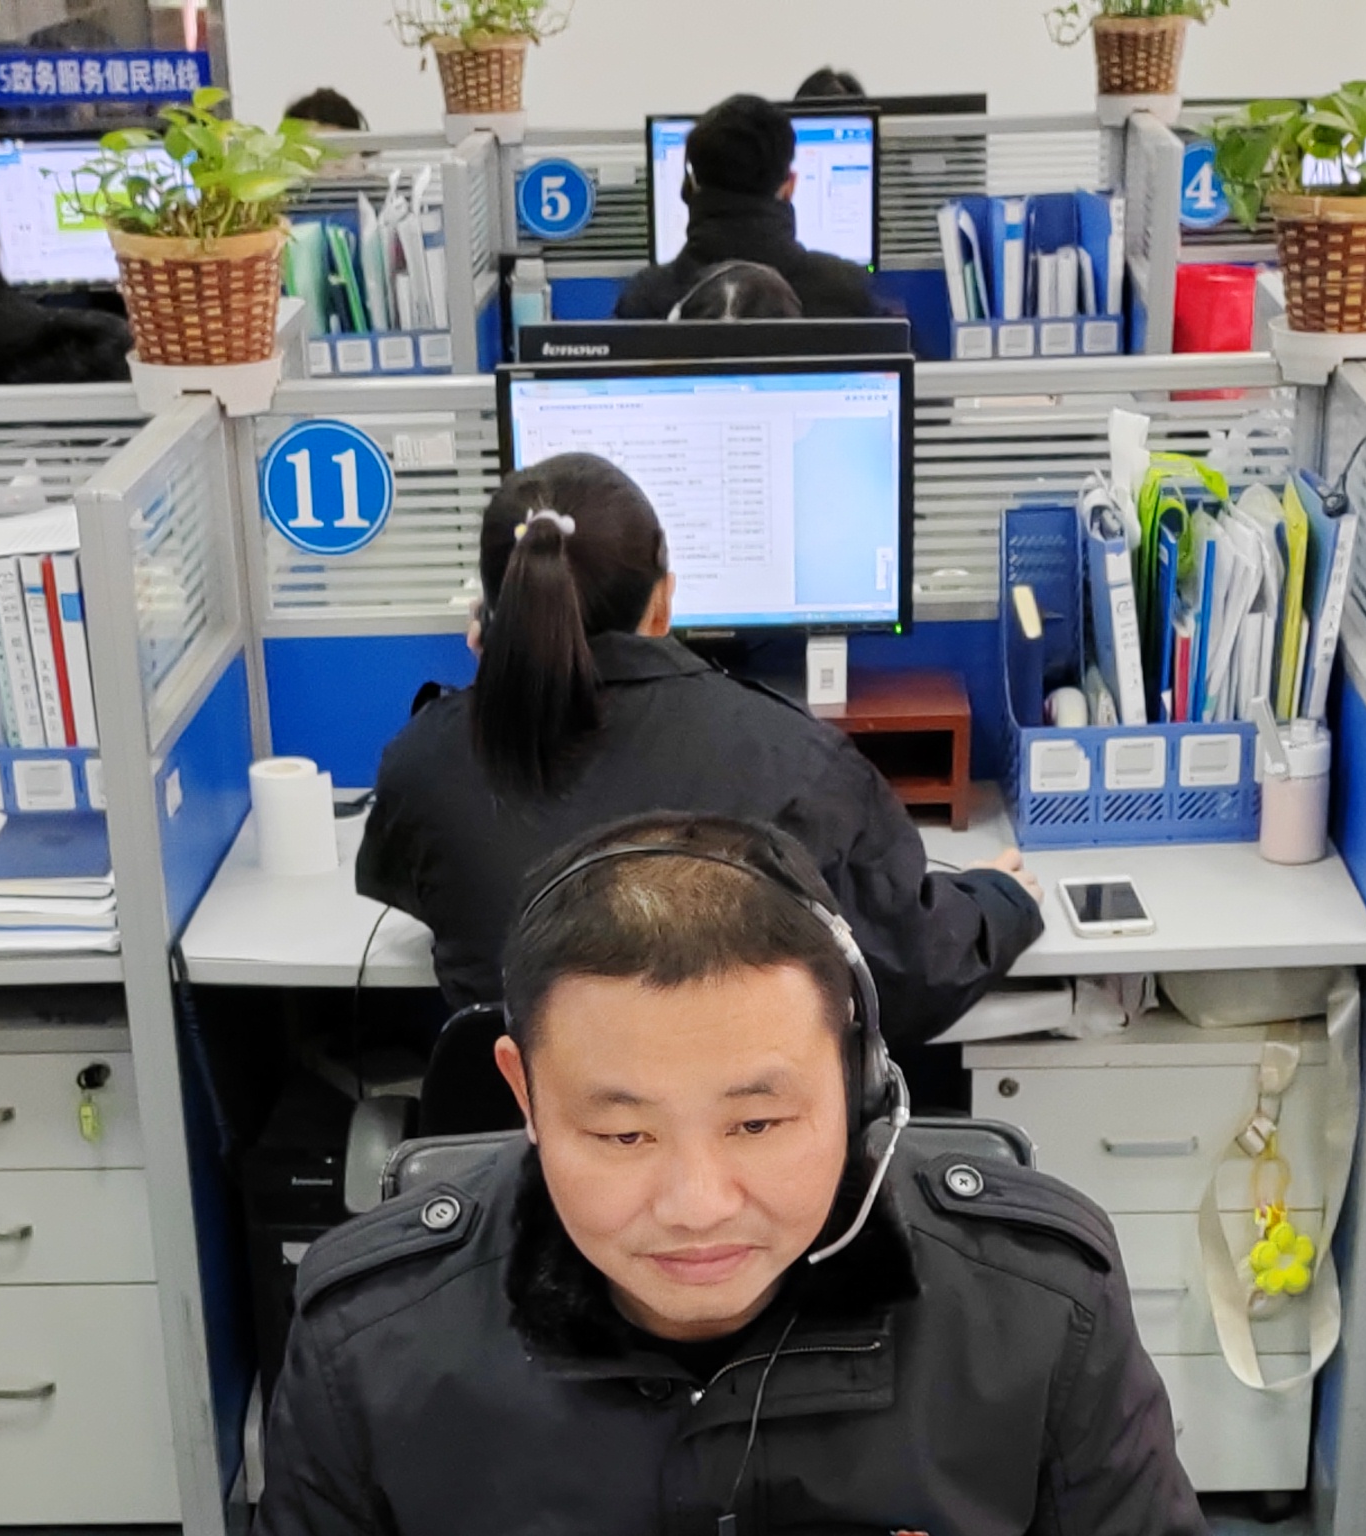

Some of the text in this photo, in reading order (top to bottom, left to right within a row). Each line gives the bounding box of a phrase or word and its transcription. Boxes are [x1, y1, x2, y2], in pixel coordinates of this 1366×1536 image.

[540, 175, 571, 222] 5
[1184, 161, 1218, 210] 4
[284, 447, 371, 529] 11
